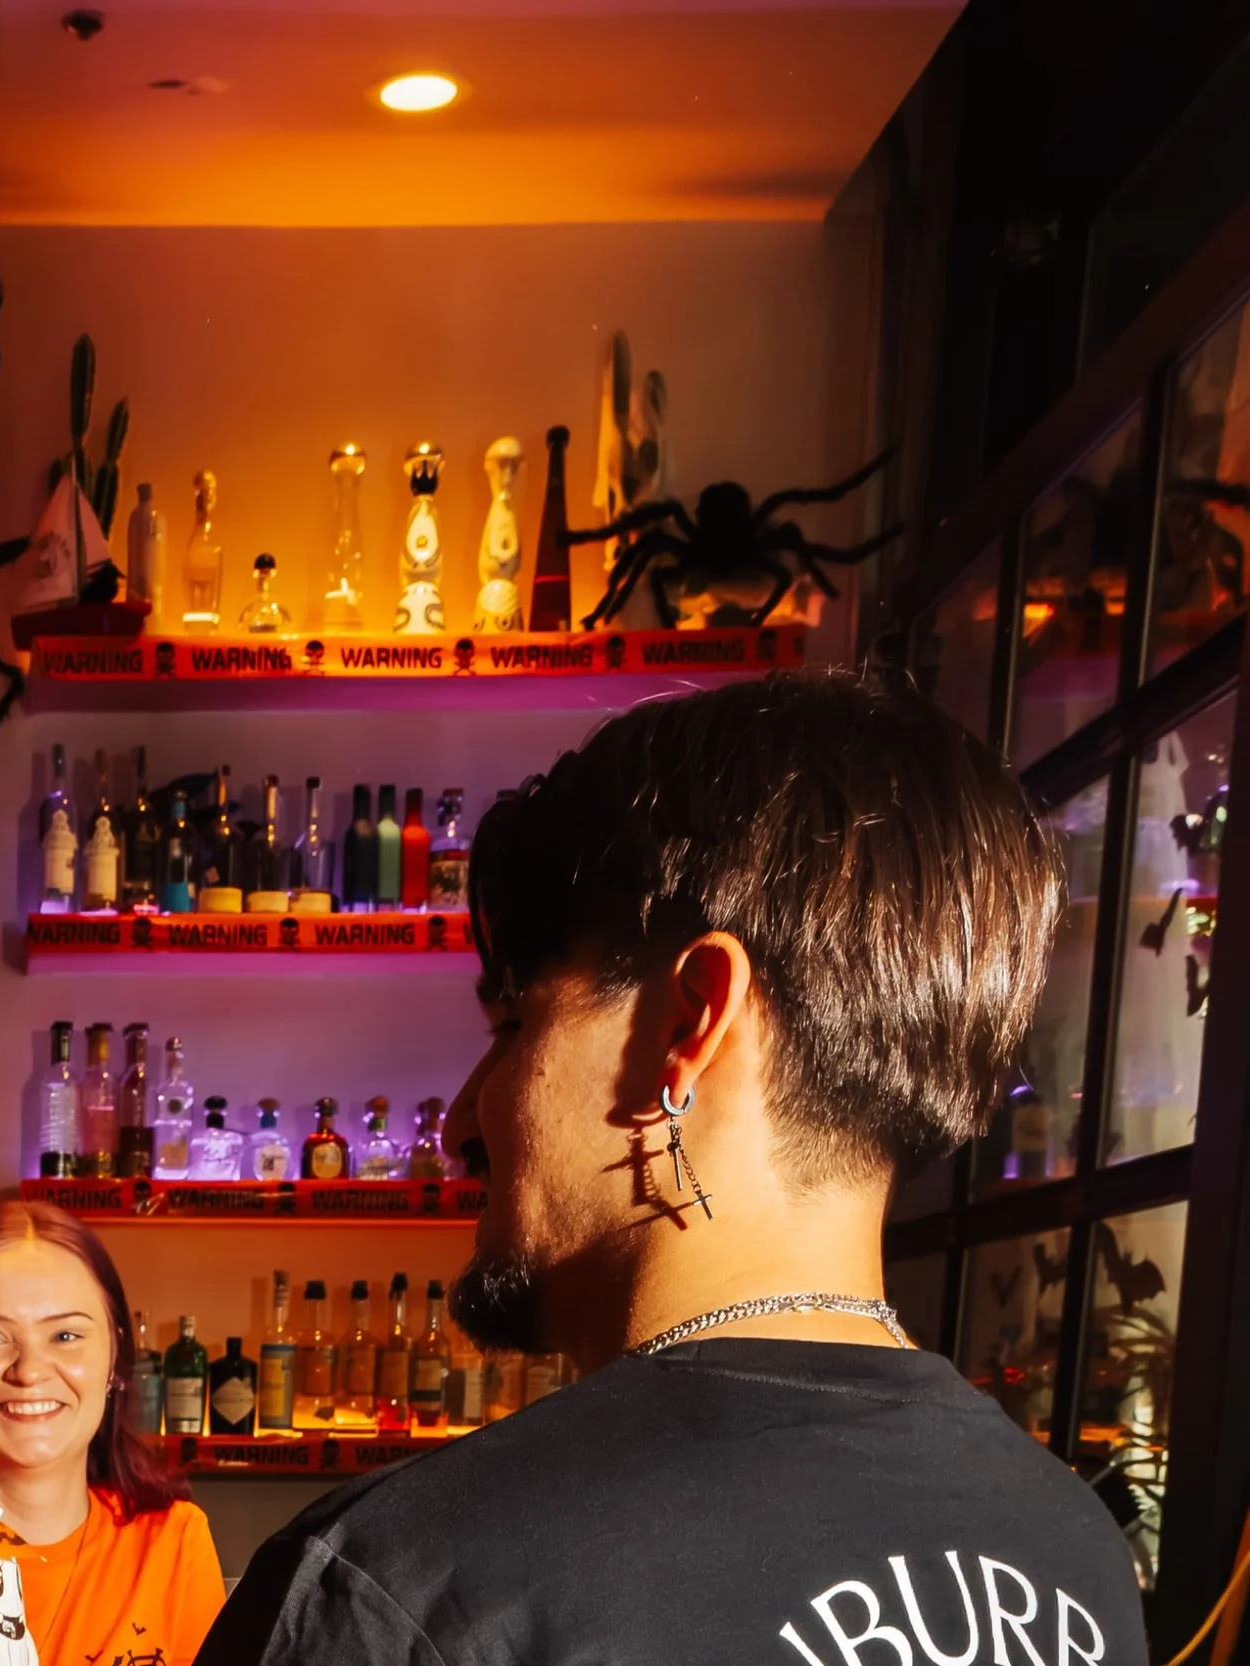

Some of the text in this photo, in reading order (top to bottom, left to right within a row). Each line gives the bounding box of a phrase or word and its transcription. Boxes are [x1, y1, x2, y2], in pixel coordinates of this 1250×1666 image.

[43, 639, 745, 673] WARNING WARNING WARNING WARNING WARNING
[168, 923, 268, 947] WARNING
[315, 923, 415, 947] WARNING
[167, 1188, 265, 1210] WARNING
[312, 1189, 409, 1212] WARNING
[214, 1444, 309, 1466] WARNING
